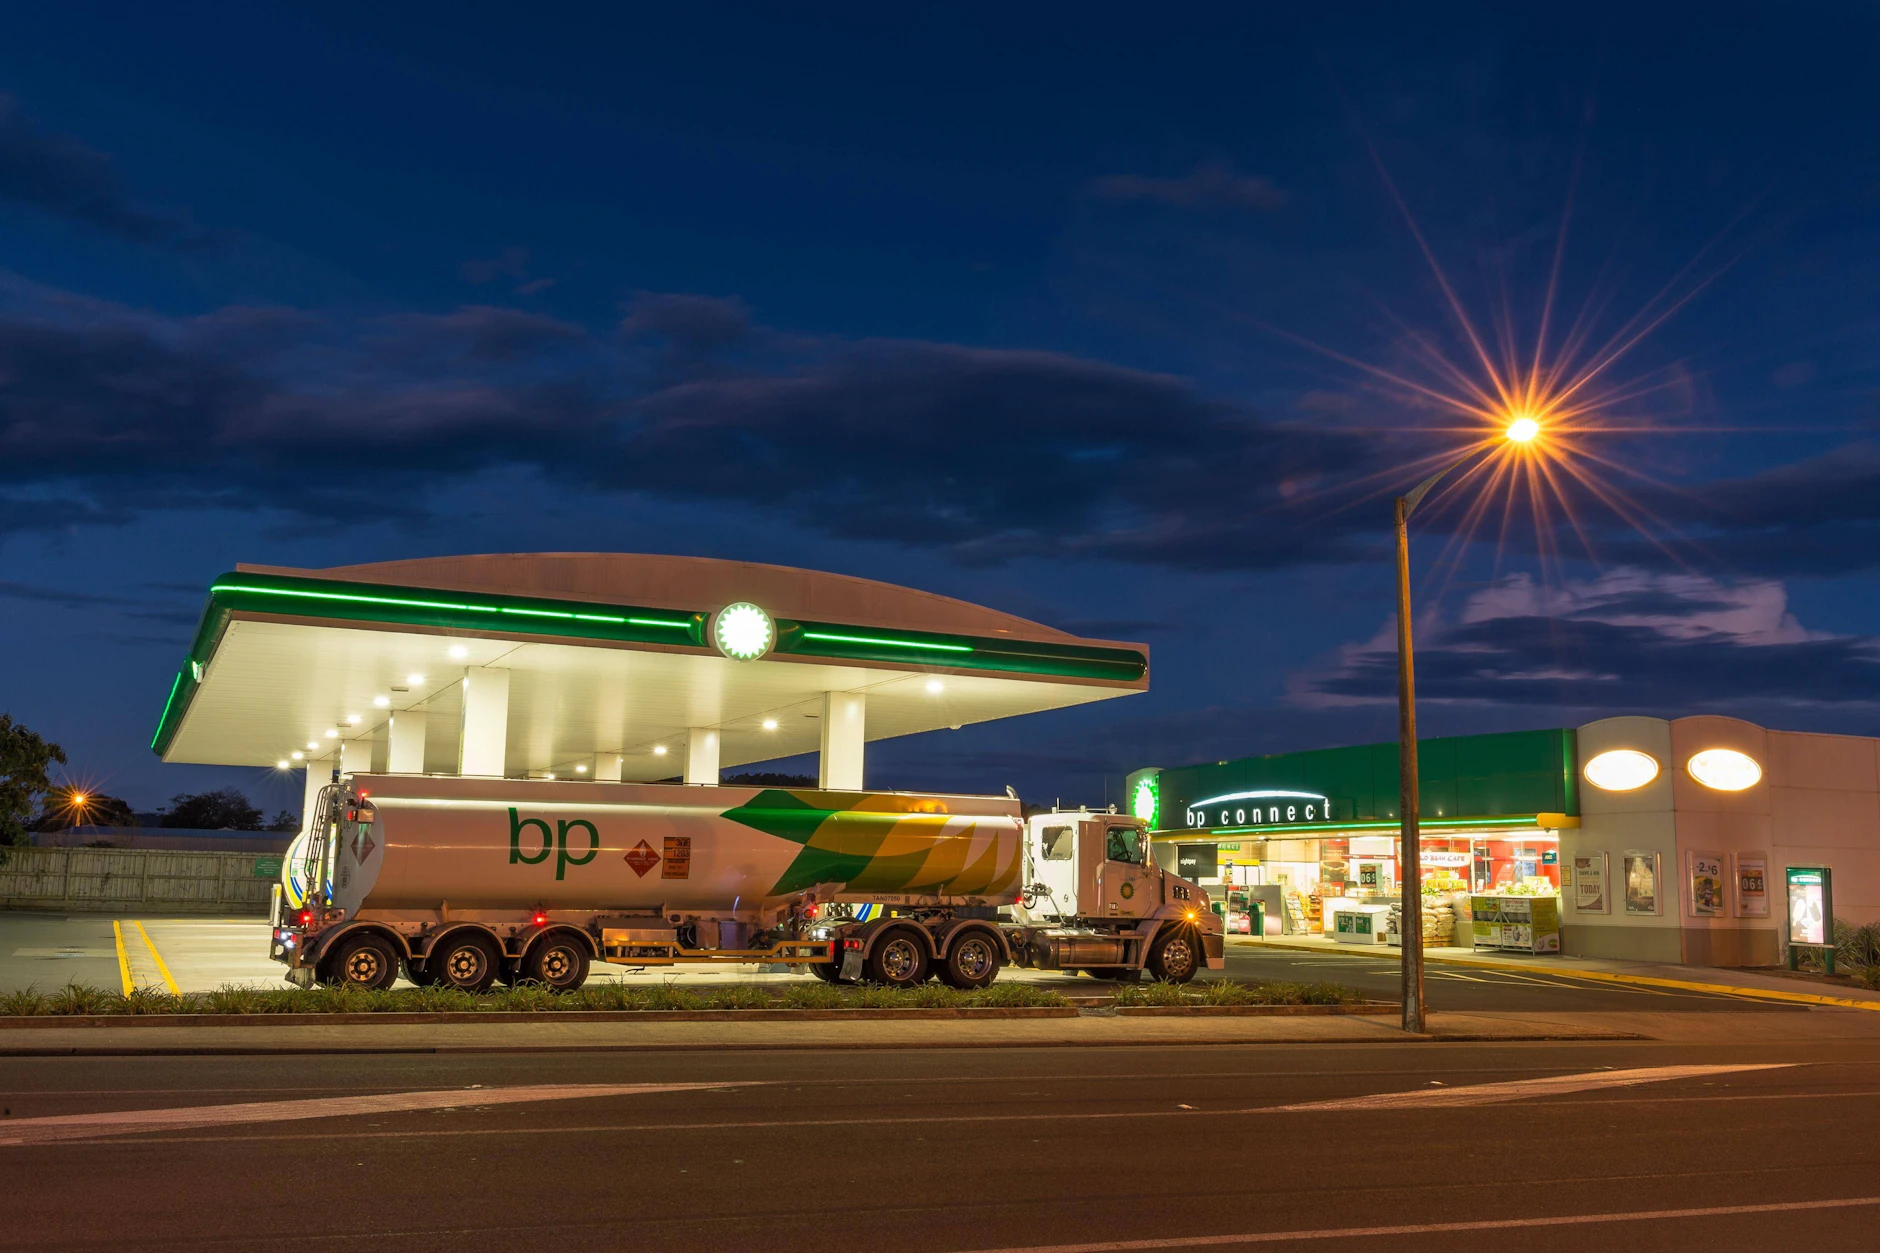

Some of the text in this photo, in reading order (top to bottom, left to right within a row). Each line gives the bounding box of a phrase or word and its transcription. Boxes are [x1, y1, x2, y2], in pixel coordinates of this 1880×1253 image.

[1186, 798, 1330, 828] bp connect
[508, 807, 599, 880] bp
[673, 849, 690, 858] 1203
[1579, 884, 1601, 894] TODAY
